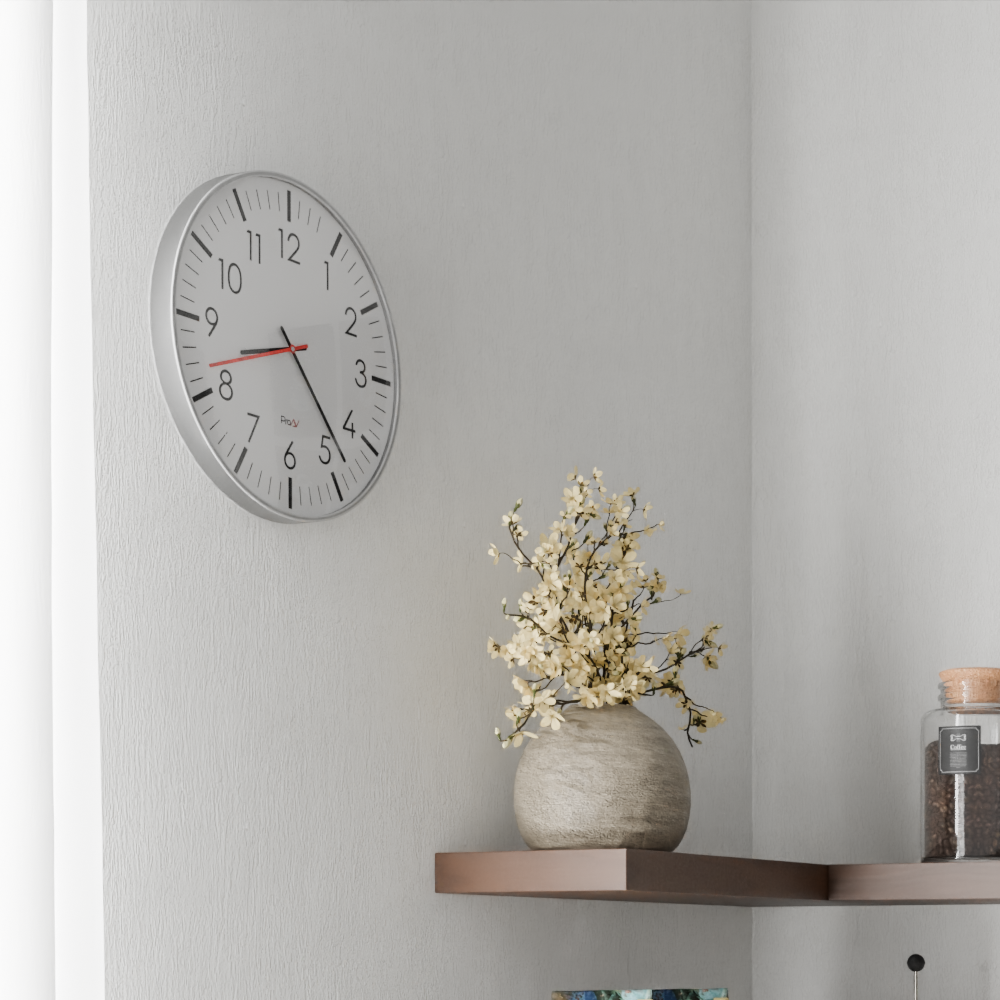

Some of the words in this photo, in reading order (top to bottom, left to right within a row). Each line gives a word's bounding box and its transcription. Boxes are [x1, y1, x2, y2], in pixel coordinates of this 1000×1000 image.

[246, 229, 261, 264] 11
[277, 228, 301, 265] 12
[218, 257, 243, 294] 10
[323, 260, 329, 291] 1
[204, 306, 219, 337] 9
[344, 306, 358, 338] 2
[218, 369, 234, 401] 8
[354, 358, 367, 389] 3
[246, 412, 260, 443] 7
[342, 409, 356, 439] 4
[283, 440, 297, 471] 6
[318, 434, 332, 465] 5
